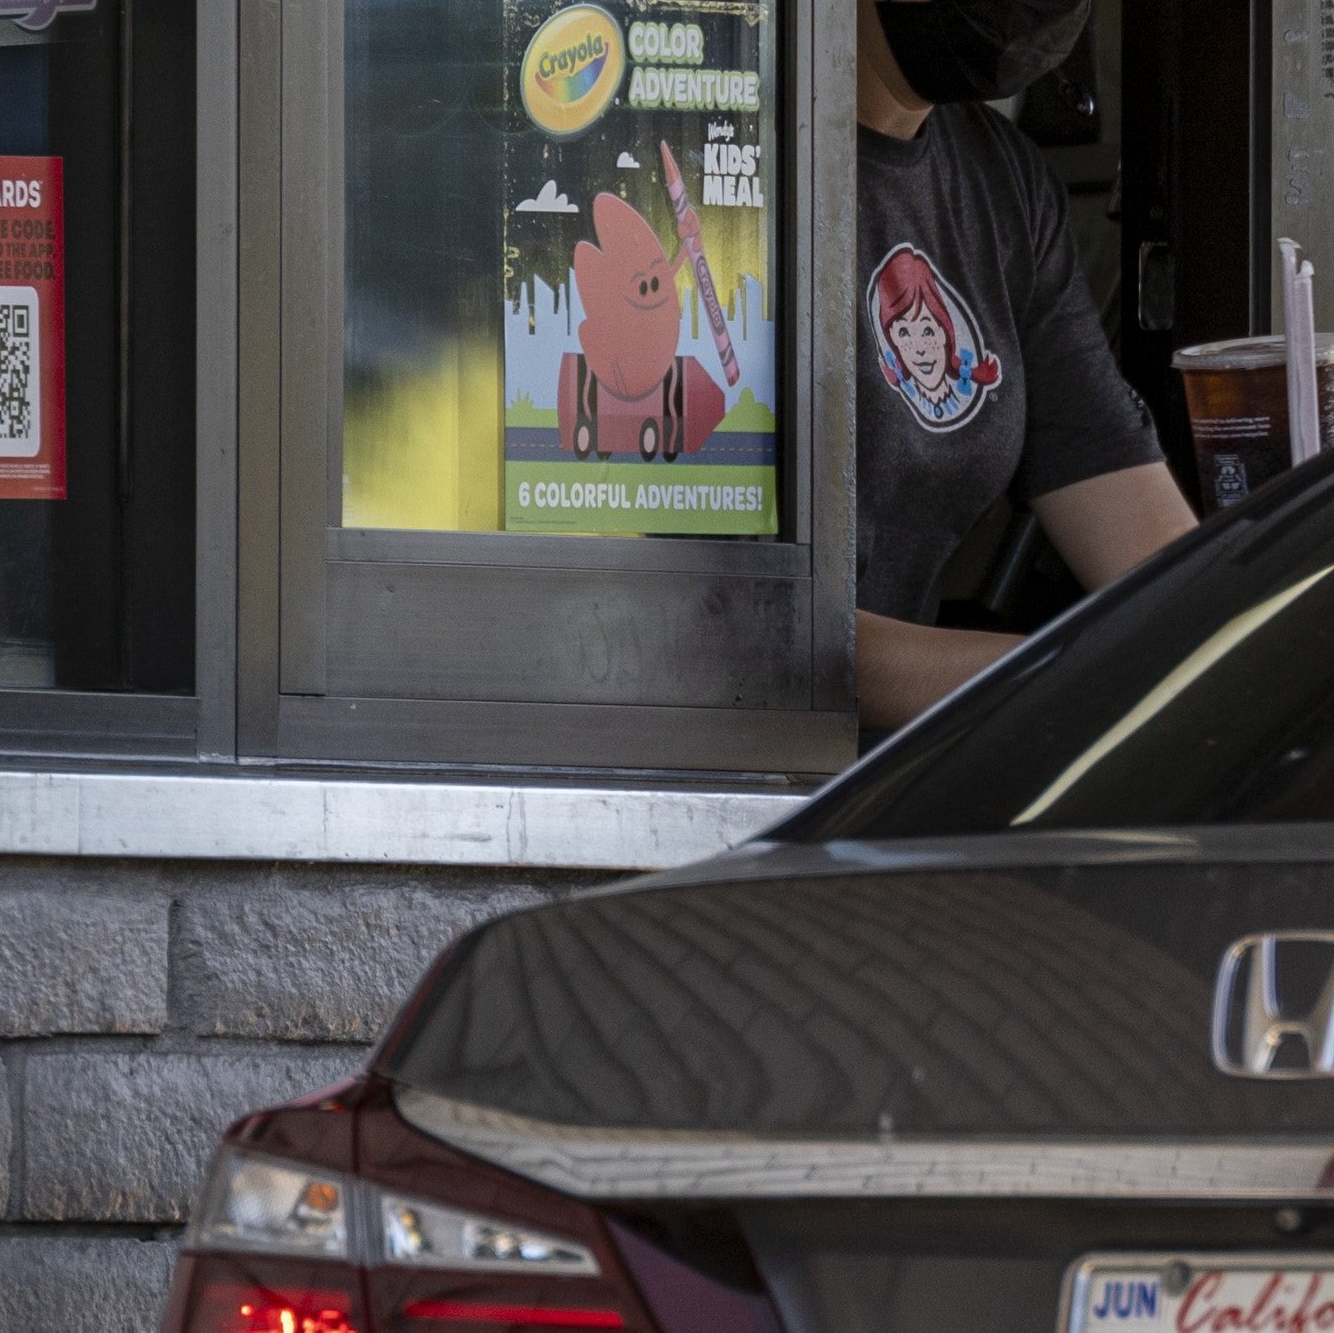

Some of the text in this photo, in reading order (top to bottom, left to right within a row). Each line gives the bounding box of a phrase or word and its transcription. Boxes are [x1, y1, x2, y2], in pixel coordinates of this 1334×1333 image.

[538, 33, 604, 78] Crayola
[630, 24, 702, 60] COLOR
[630, 70, 758, 106] ADVENTURE
[704, 143, 761, 176] KIDS'
[703, 175, 764, 207] MEAL
[6, 242, 27, 258] THE
[518, 481, 763, 511] 6 COLORFUL ADVENTURES!
[1093, 1280, 1158, 1318] JUN
